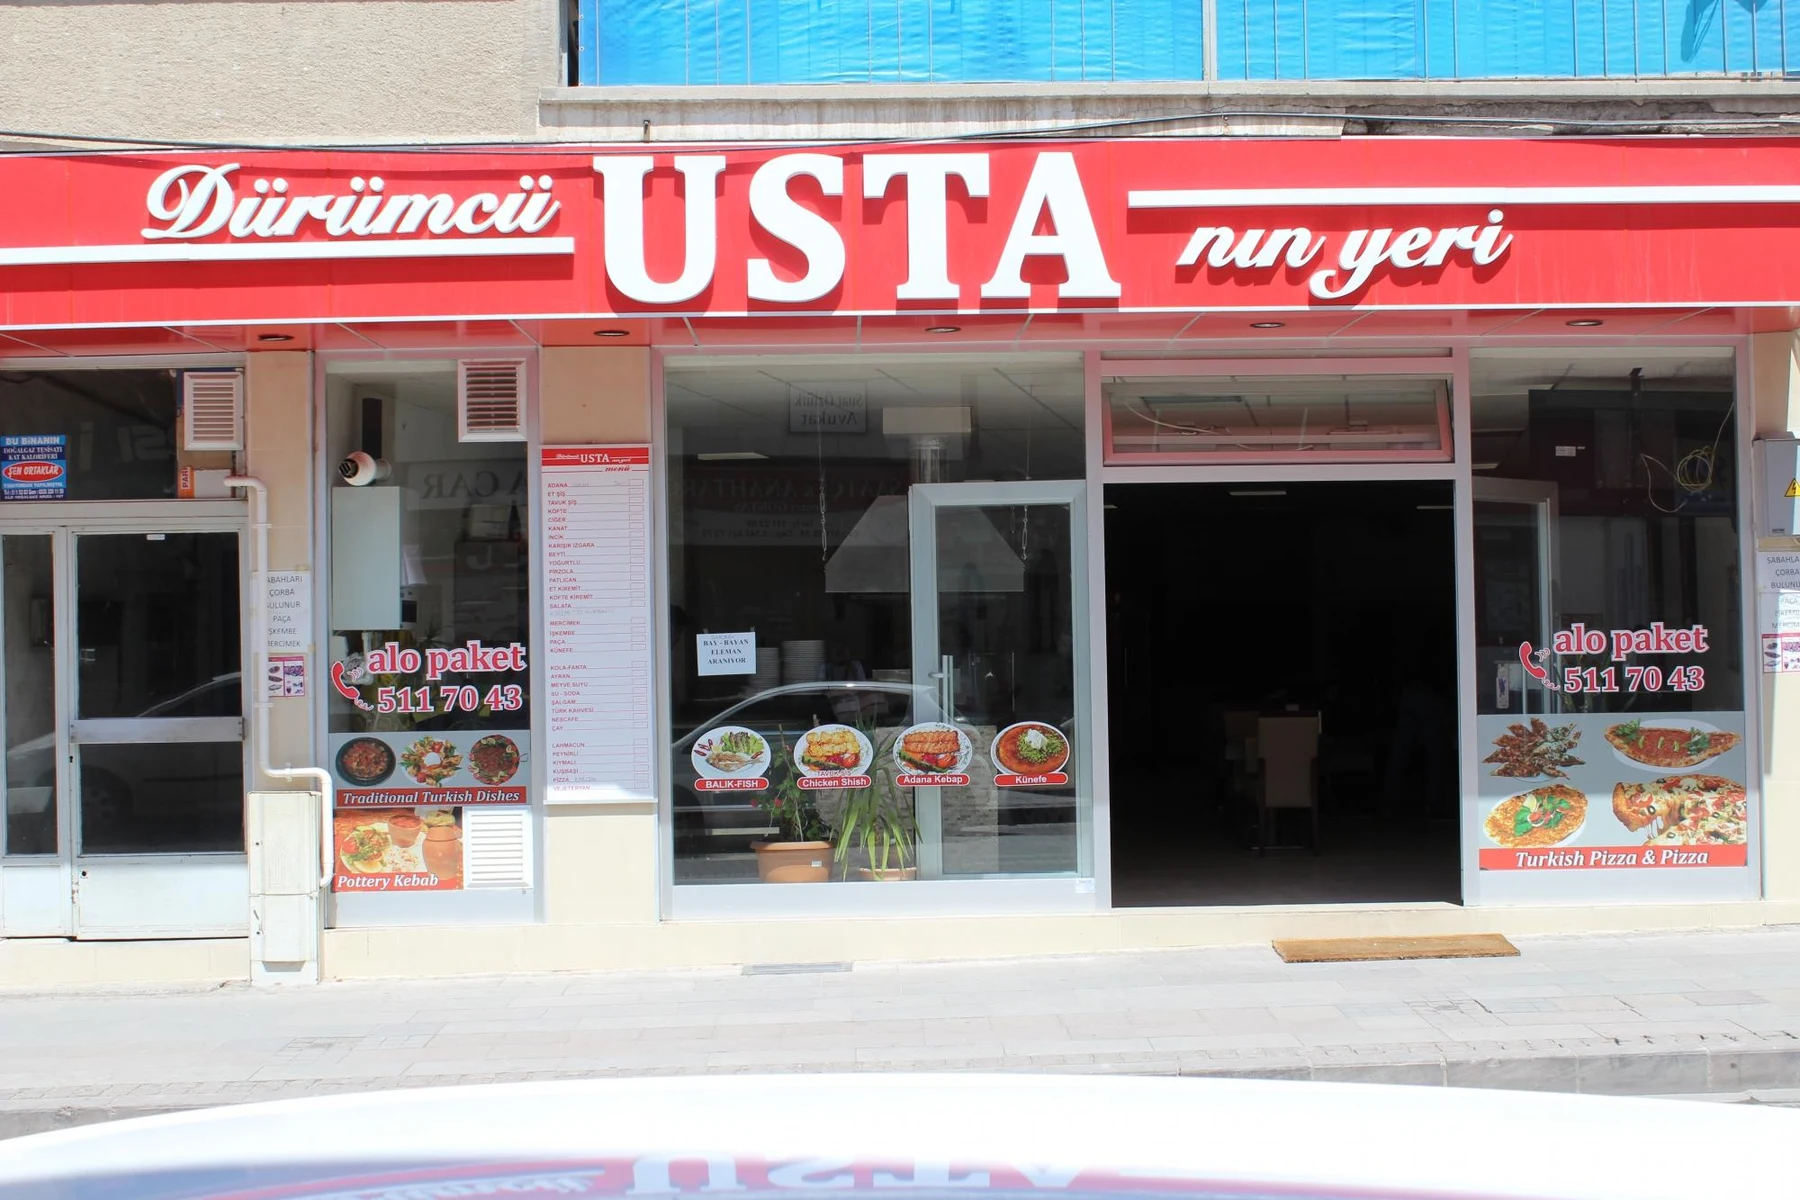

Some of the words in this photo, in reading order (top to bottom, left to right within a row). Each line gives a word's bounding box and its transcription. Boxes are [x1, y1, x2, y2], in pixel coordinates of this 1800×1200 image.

[140, 163, 561, 240] Dürümcü
[593, 151, 1122, 304] USTA
[1308, 208, 1514, 300] yeri
[5, 437, 19, 445] BU
[580, 453, 610, 463] USTA
[1775, 568, 1800, 577] ÇORBA
[267, 575, 303, 584] ABAHLARI
[269, 588, 295, 597] ÇORBA
[267, 601, 300, 610] ULUNUR
[272, 615, 291, 624] PAÇA
[268, 628, 297, 636] ŞKEMBE
[1553, 622, 1607, 655] alo
[1611, 621, 1709, 661] paket
[367, 641, 421, 673] alo
[425, 640, 528, 681] paket
[1564, 666, 1619, 693] 511
[1625, 666, 1662, 692] 70
[1667, 665, 1705, 691] 43
[377, 686, 434, 713] 511
[440, 685, 479, 711] 70
[484, 684, 522, 711] 43
[705, 780, 759, 789] BALIK-FISH
[802, 778, 839, 787] Chicken
[841, 777, 867, 787] Shish
[903, 775, 932, 784] Adana
[933, 774, 963, 785] Kebap
[1015, 775, 1048, 785] Künefe
[343, 792, 418, 804] Traditional
[422, 790, 473, 803] Turkish
[476, 790, 520, 802] Dishes
[1515, 851, 1584, 868] Turkish
[1589, 851, 1637, 866] Pizza
[1642, 850, 1657, 865] &
[1661, 849, 1709, 865] Pizza
[338, 874, 391, 890] Pottery
[394, 874, 439, 887] Kebab
